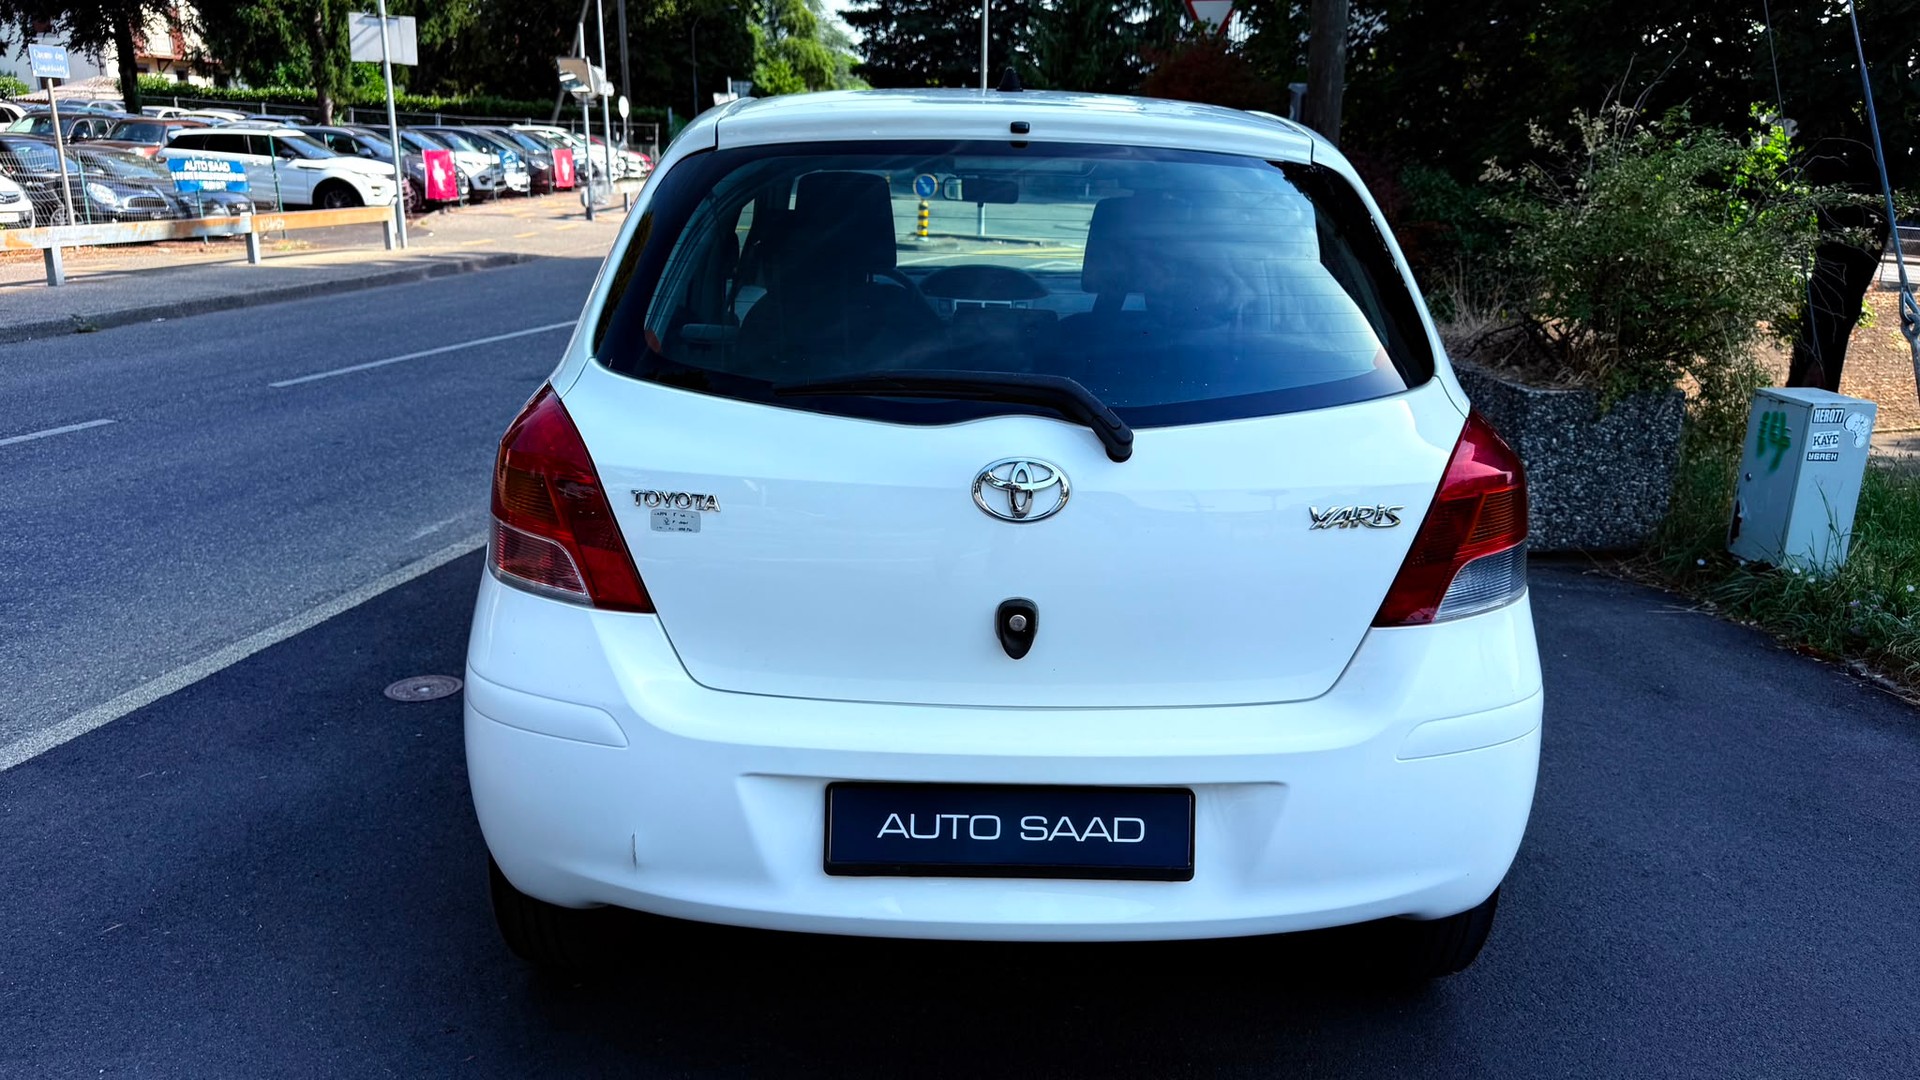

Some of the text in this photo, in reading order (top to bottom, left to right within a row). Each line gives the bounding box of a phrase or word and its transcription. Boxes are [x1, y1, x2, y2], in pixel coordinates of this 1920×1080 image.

[184, 160, 207, 172] AUTO
[1812, 434, 1839, 446] KAYE
[631, 489, 721, 512] TOYOTA
[877, 812, 1146, 843] AUTO SAAD
